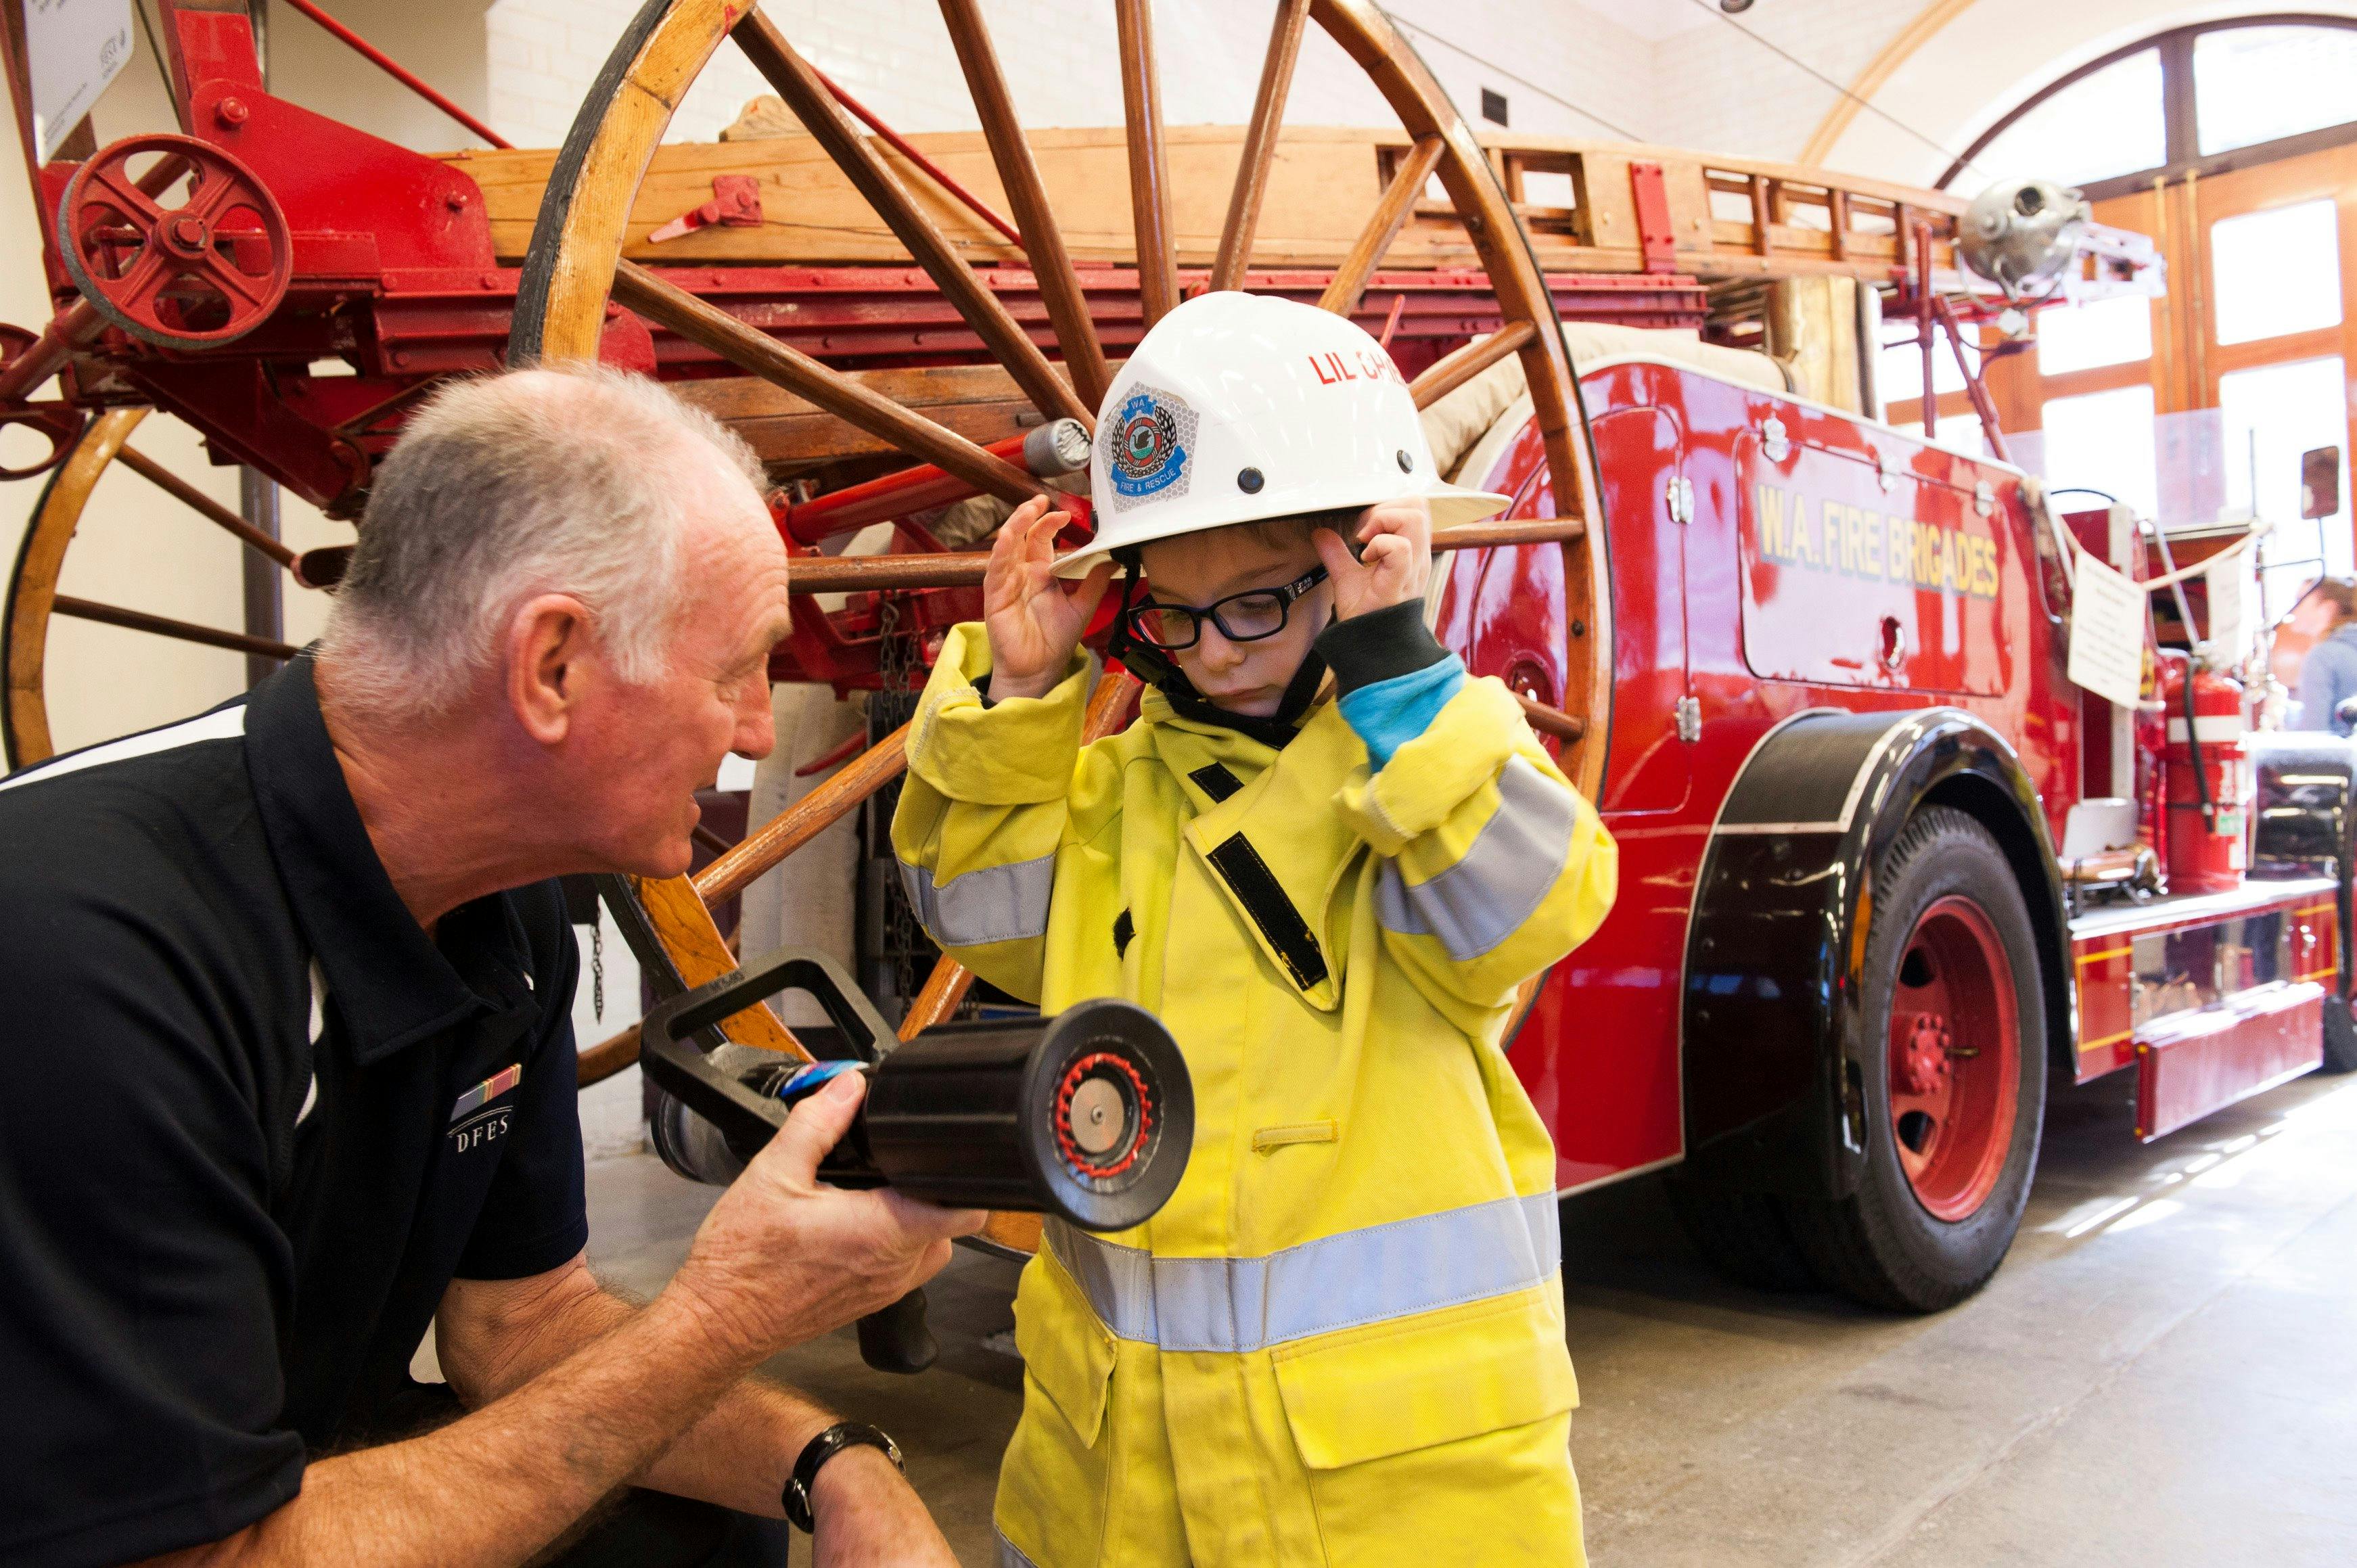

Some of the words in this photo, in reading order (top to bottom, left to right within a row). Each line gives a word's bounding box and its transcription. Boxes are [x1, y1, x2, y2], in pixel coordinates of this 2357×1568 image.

[1308, 352, 1357, 384] LIL
[1130, 400, 1147, 409] WA
[1120, 482, 1135, 492] FIRE
[1137, 483, 1142, 492] &
[1145, 467, 1176, 490] RESCUE
[1823, 499, 1881, 578] FIRE
[1887, 515, 1999, 599] BRIGADES
[457, 1114, 509, 1153] DFES
